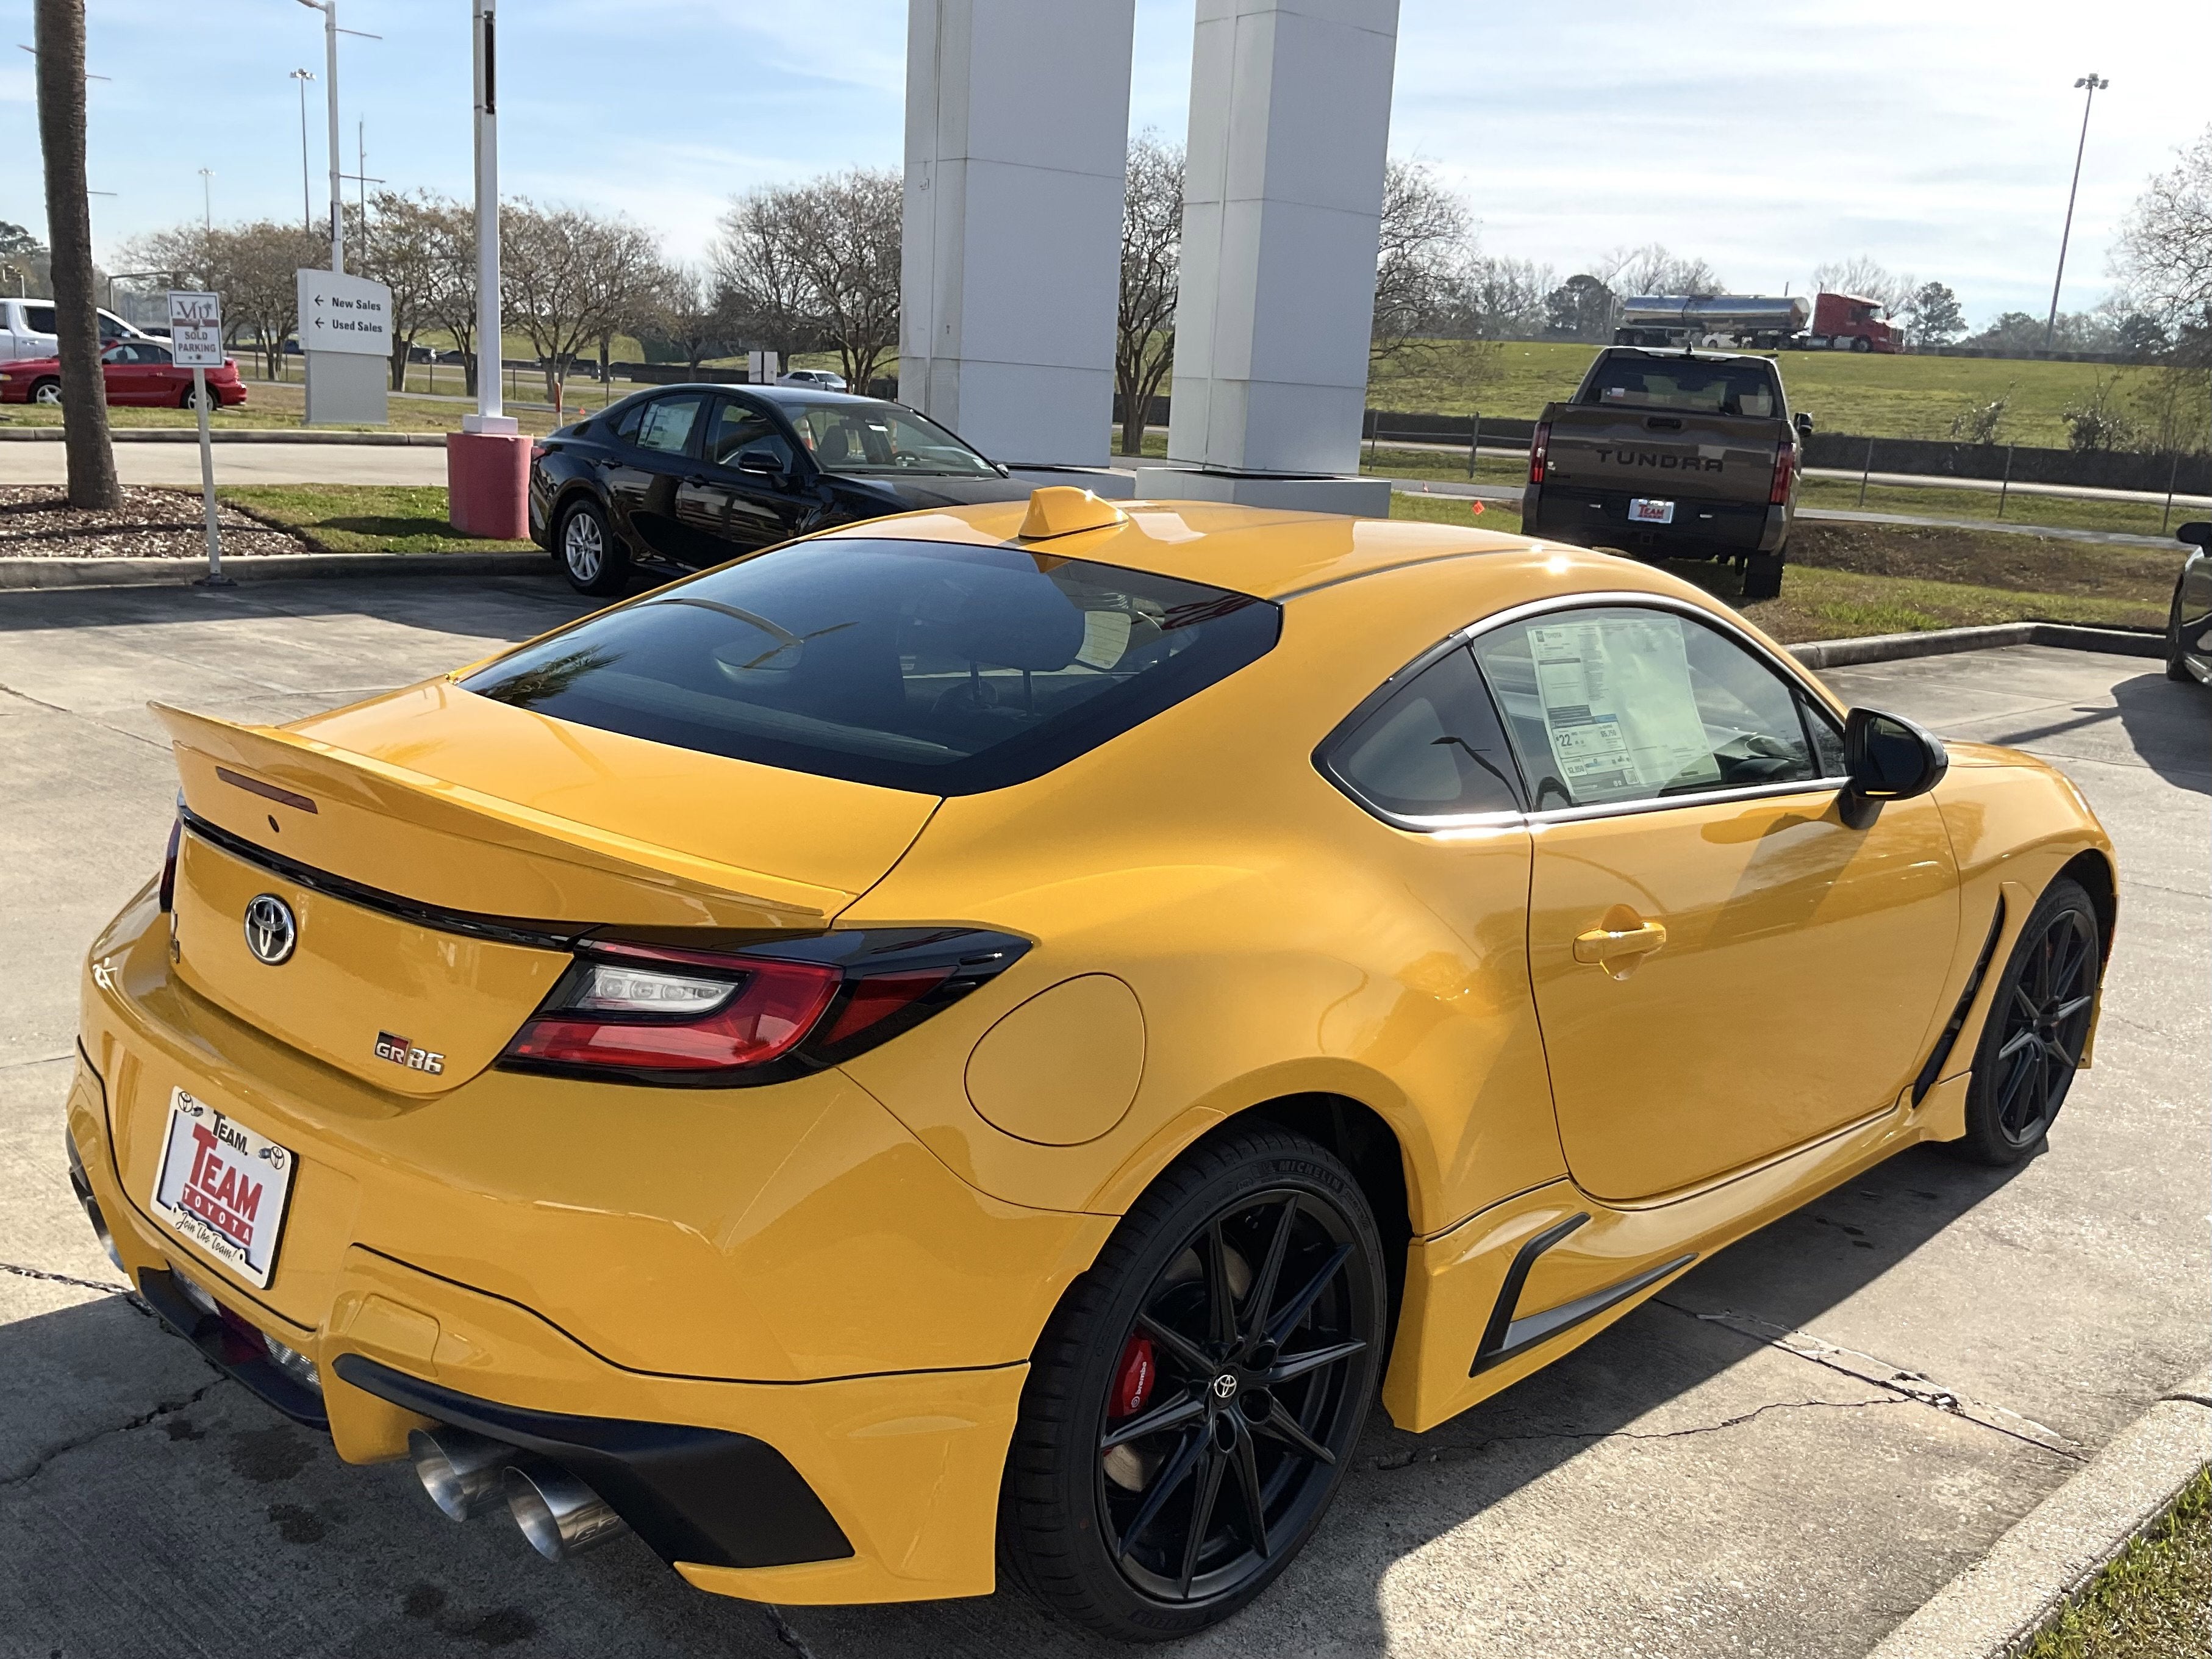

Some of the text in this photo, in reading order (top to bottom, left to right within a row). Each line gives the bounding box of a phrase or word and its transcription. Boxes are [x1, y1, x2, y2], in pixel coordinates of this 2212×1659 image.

[332, 297, 381, 311] New Sales
[332, 319, 382, 332] Used Sales
[184, 331, 208, 340] SOLD
[178, 343, 216, 353] PARKING
[1595, 449, 1723, 473] TUNDRA
[1639, 504, 1665, 516] TEAM
[1559, 734, 1572, 747] 22
[189, 1122, 263, 1222] TEAM
[1279, 1160, 1343, 1191] MICHELIN
[184, 1188, 249, 1242] TOYOTA
[176, 1212, 238, 1261] Join The Team!
[1135, 1361, 1147, 1395] brembo
